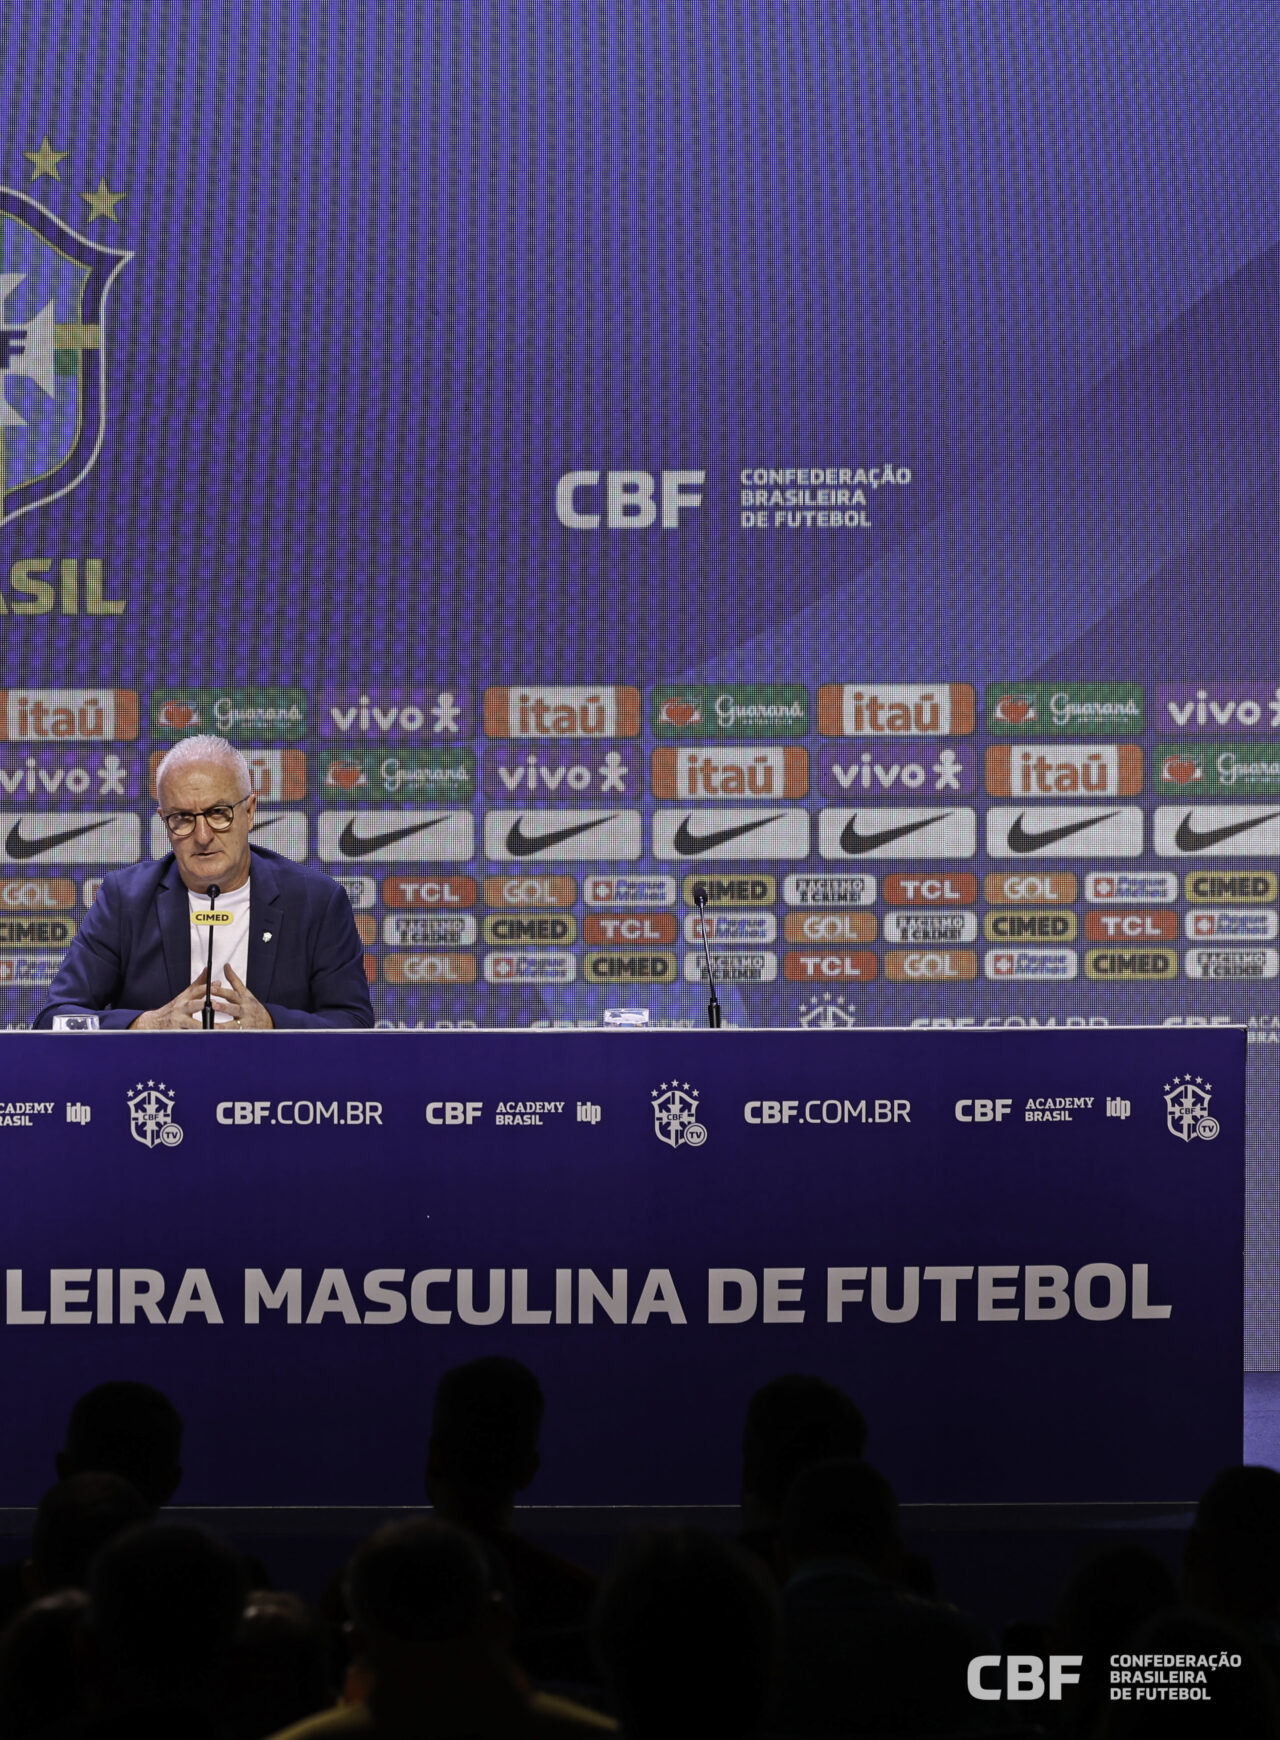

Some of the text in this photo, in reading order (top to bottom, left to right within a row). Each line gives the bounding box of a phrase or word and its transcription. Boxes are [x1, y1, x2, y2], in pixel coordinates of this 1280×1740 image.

[740, 464, 912, 489] CONFEDERAÇÃO
[556, 470, 706, 529] CBF
[740, 489, 867, 506] BRASILEIRA
[741, 510, 872, 528] DE FUTEBOL
[18, 697, 104, 737] itaú
[213, 698, 302, 731] Guaraná
[331, 697, 424, 730] vivo
[520, 696, 605, 734] itaú
[714, 695, 804, 727] Guaraná
[854, 693, 940, 732] itaú
[1049, 693, 1139, 725] Guaraná
[1168, 692, 1261, 725] vivo
[380, 759, 470, 791] Guaraná
[499, 756, 591, 790] vivo
[689, 755, 773, 794] itaú
[833, 755, 925, 788] vivo
[1022, 754, 1107, 792] itaú
[1216, 753, 1280, 785] Guara
[2, 882, 57, 906] GOL
[400, 882, 459, 902] TCL
[503, 879, 557, 903] GOL
[900, 880, 960, 899] TCL
[1004, 877, 1057, 900] GOL
[1193, 877, 1269, 897] CIMED
[492, 919, 568, 939] CIMED
[600, 919, 660, 939] TCL
[803, 915, 857, 939] GOL
[993, 917, 1068, 936] CIMED
[1101, 916, 1161, 936] TCL
[403, 956, 457, 980] GOL
[592, 957, 668, 977] CIMED
[800, 956, 860, 976] TCL
[904, 953, 956, 977] GOL
[1093, 954, 1169, 979] CIMED
[67, 1102, 90, 1126] idp
[216, 1101, 383, 1125] CBF.COM.BR
[425, 1102, 483, 1125] CBF
[496, 1102, 565, 1113] ACADEMY
[577, 1101, 601, 1125] idp
[744, 1100, 911, 1123] CBF.COM.BR
[955, 1099, 1012, 1122] CBF
[1026, 1097, 1094, 1109] ACADEMY
[1107, 1097, 1130, 1120] idp
[496, 1114, 543, 1125] BRASIL
[1025, 1110, 1073, 1121] BRASIL
[689, 1131, 702, 1139] TV
[245, 1268, 687, 1325] MASCULINA
[708, 1268, 806, 1323] DE
[827, 1263, 1172, 1323] FUTEBOL
